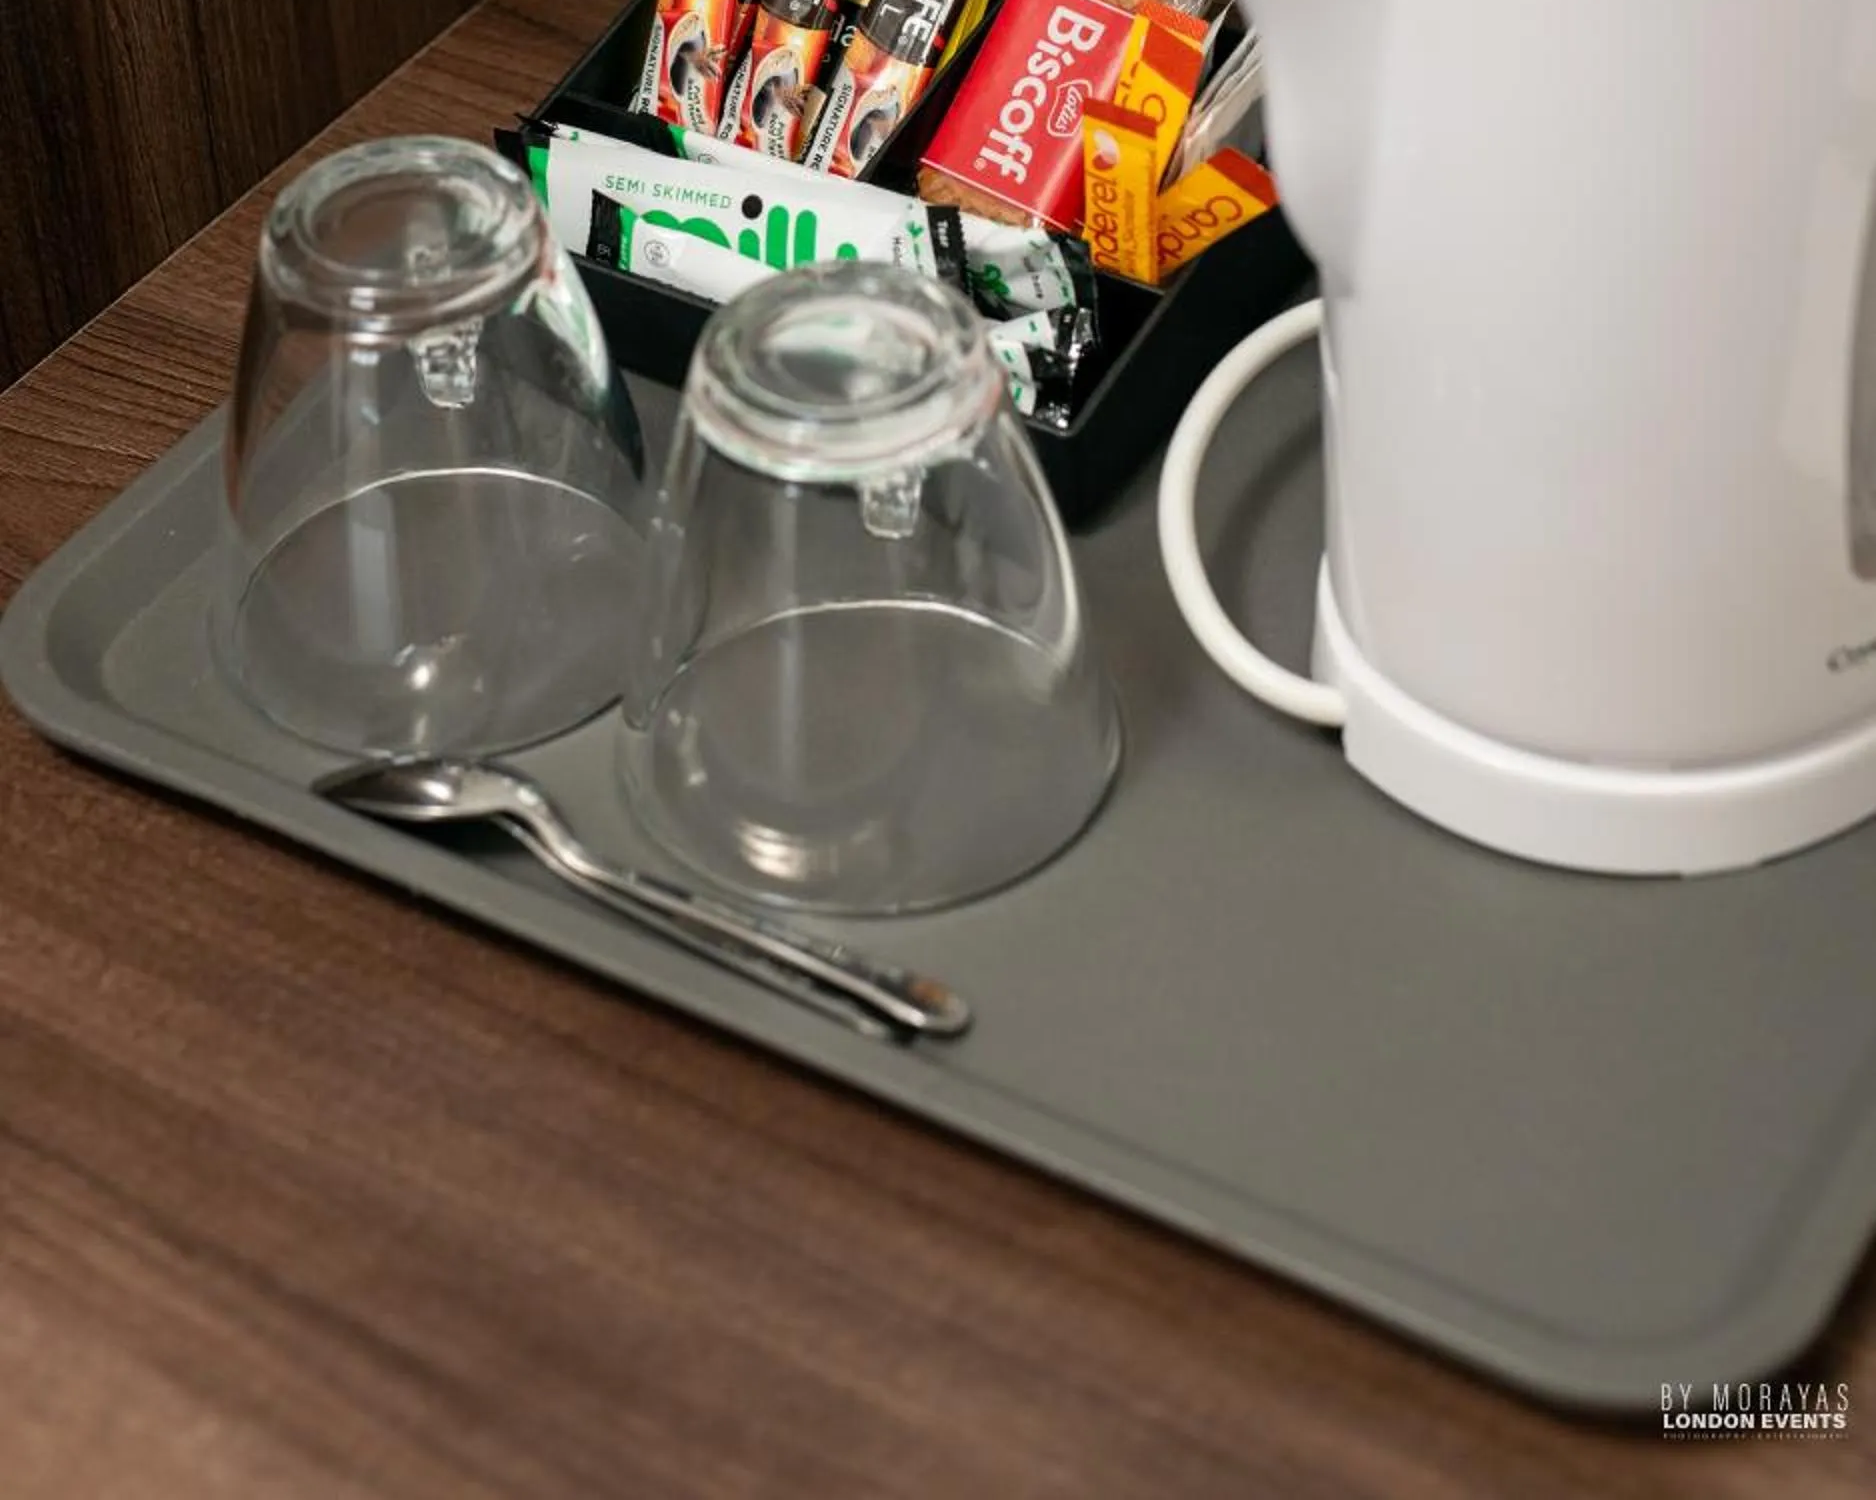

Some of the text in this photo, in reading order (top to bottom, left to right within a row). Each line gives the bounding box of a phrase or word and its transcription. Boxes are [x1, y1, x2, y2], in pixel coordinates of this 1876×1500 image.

[817, 83, 854, 153] SIGNATURE
[980, 5, 1105, 185] Biscoff
[604, 174, 733, 210] SEMI SKIMMED
[1157, 193, 1242, 267] Cand
